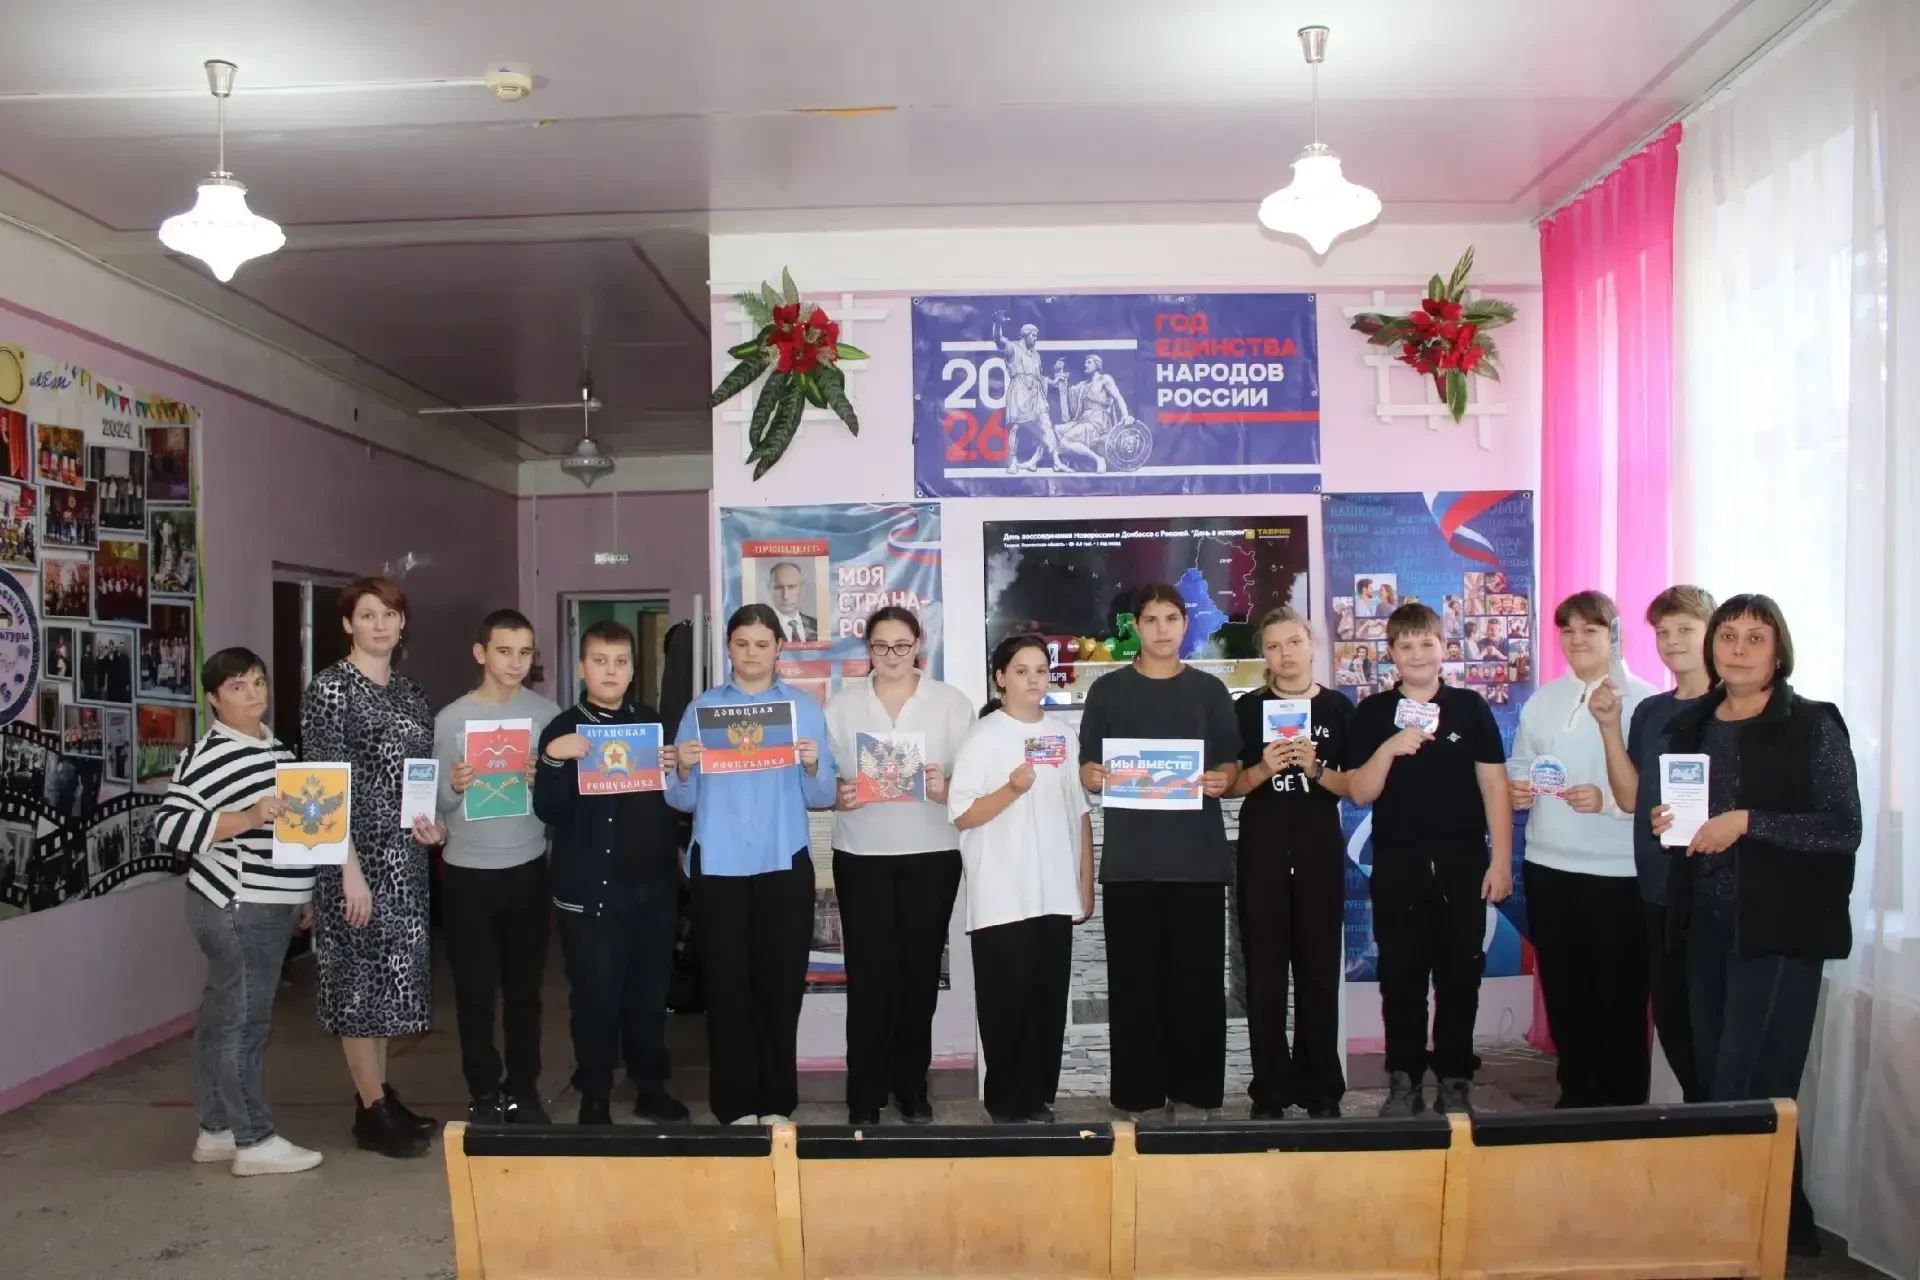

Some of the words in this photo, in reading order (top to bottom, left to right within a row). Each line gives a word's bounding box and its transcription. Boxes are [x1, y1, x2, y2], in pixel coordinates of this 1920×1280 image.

[1155, 312, 1209, 335] ГОД
[1155, 337, 1298, 358] ЕДИНСТВА
[942, 358, 1010, 409] 20
[1156, 363, 1284, 384] НАРОДОВ
[1157, 388, 1268, 408] РОССИИ
[102, 419, 132, 439] 2024
[943, 410, 1010, 462] 26
[1121, 530, 1154, 539] Донбасса
[838, 567, 885, 586] МОЯ
[1110, 759, 1134, 769] МЫ
[1138, 759, 1192, 770] ВМЕСТЕ!
